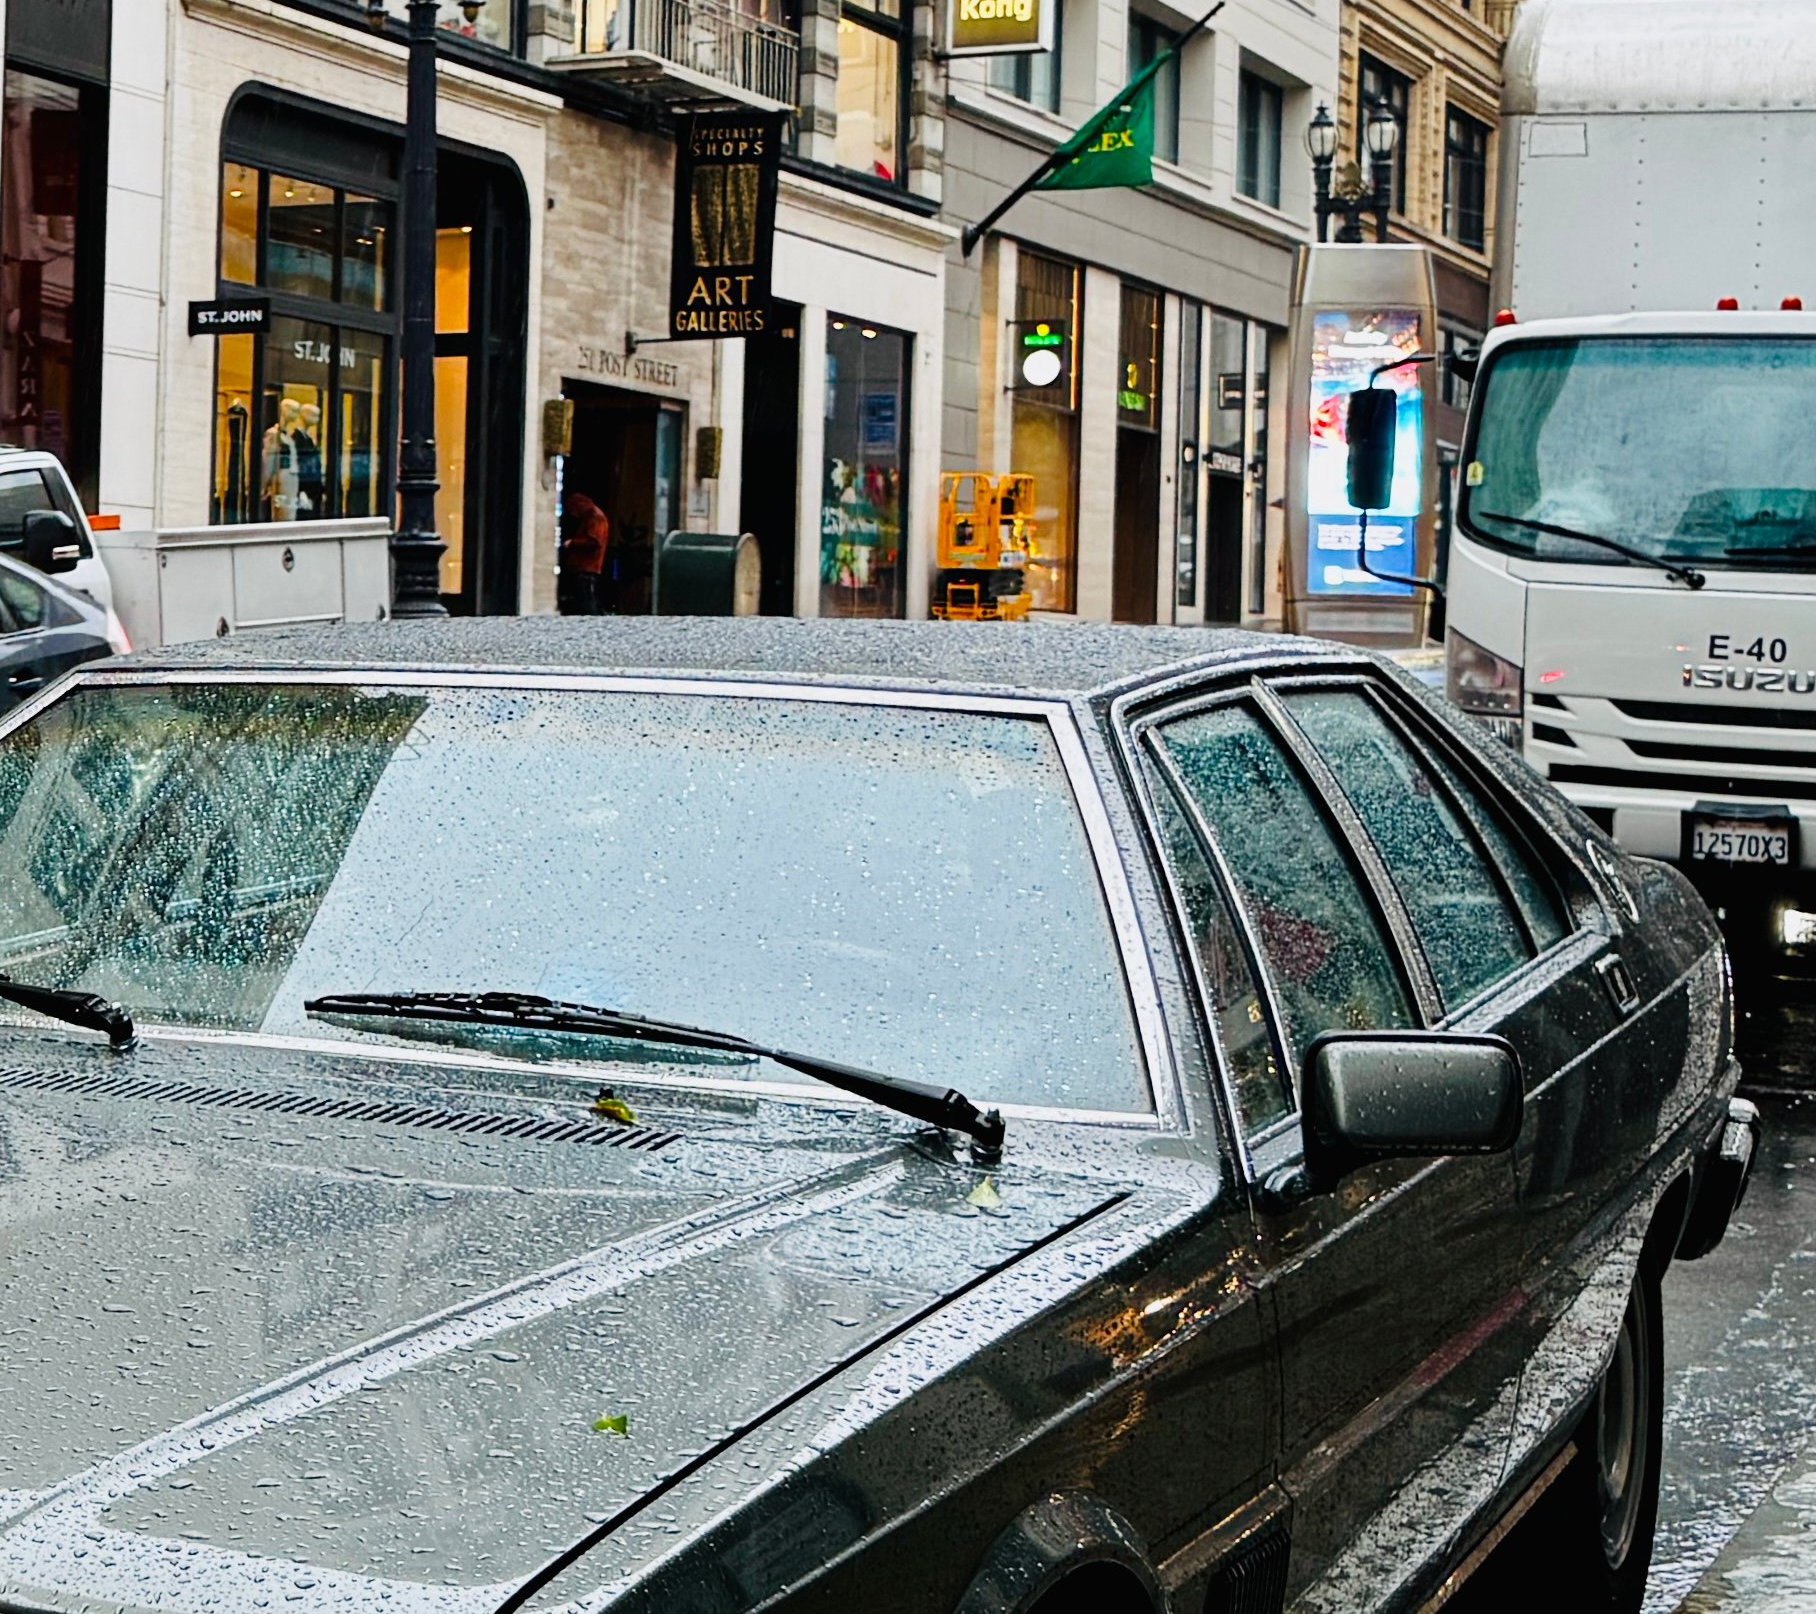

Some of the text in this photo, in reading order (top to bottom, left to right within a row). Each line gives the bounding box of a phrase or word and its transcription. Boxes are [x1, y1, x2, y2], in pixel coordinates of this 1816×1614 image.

[693, 141, 764, 157] SHOPS
[687, 275, 755, 307] ART
[676, 309, 765, 332] GALLERIES
[599, 349, 630, 378] POST
[634, 358, 679, 387] STREET
[1708, 634, 1788, 663] E-40
[1682, 663, 1816, 694] ISUZU
[1694, 831, 1786, 860] 12570X3
